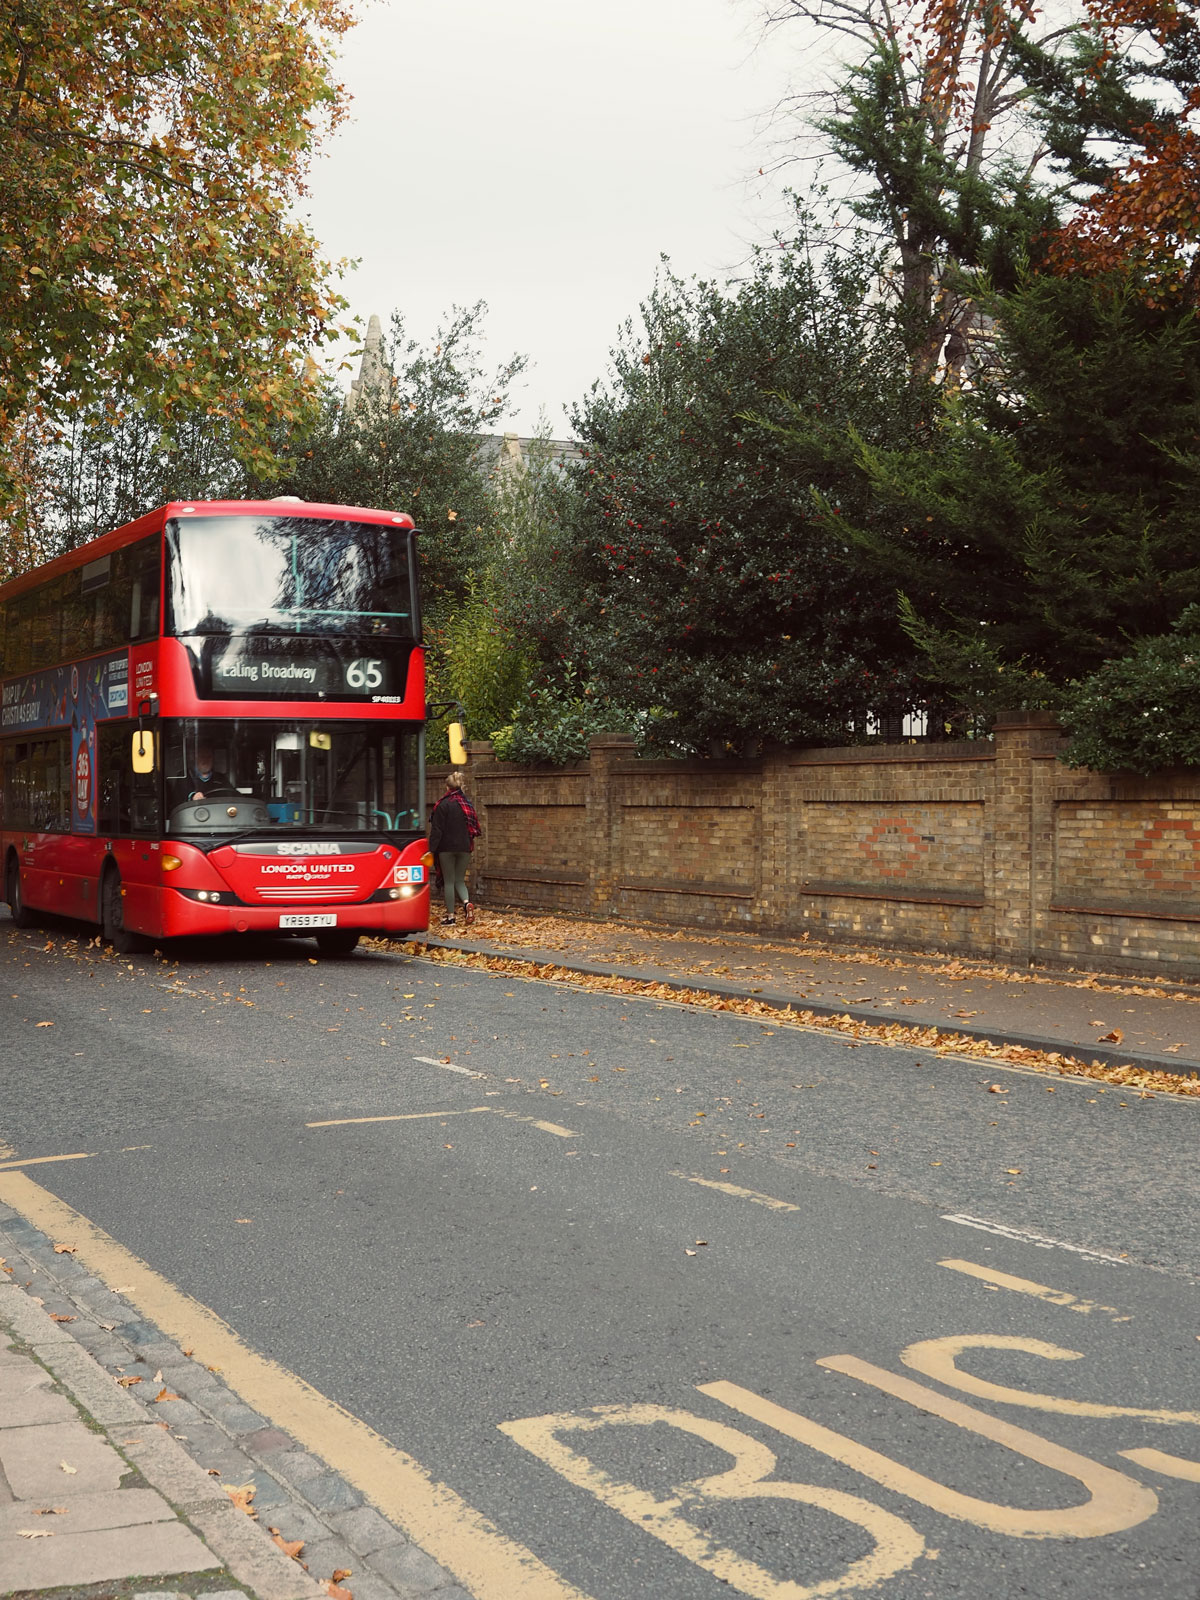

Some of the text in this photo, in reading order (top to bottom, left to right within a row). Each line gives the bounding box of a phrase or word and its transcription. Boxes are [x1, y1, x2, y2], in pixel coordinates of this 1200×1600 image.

[261, 662, 317, 683] Broadway
[346, 659, 383, 688] 65
[277, 843, 342, 855] SCANIA
[261, 864, 355, 874] LONDON UNITED
[284, 915, 332, 926] YR59 FYU
[497, 1334, 1200, 1600] BUS
